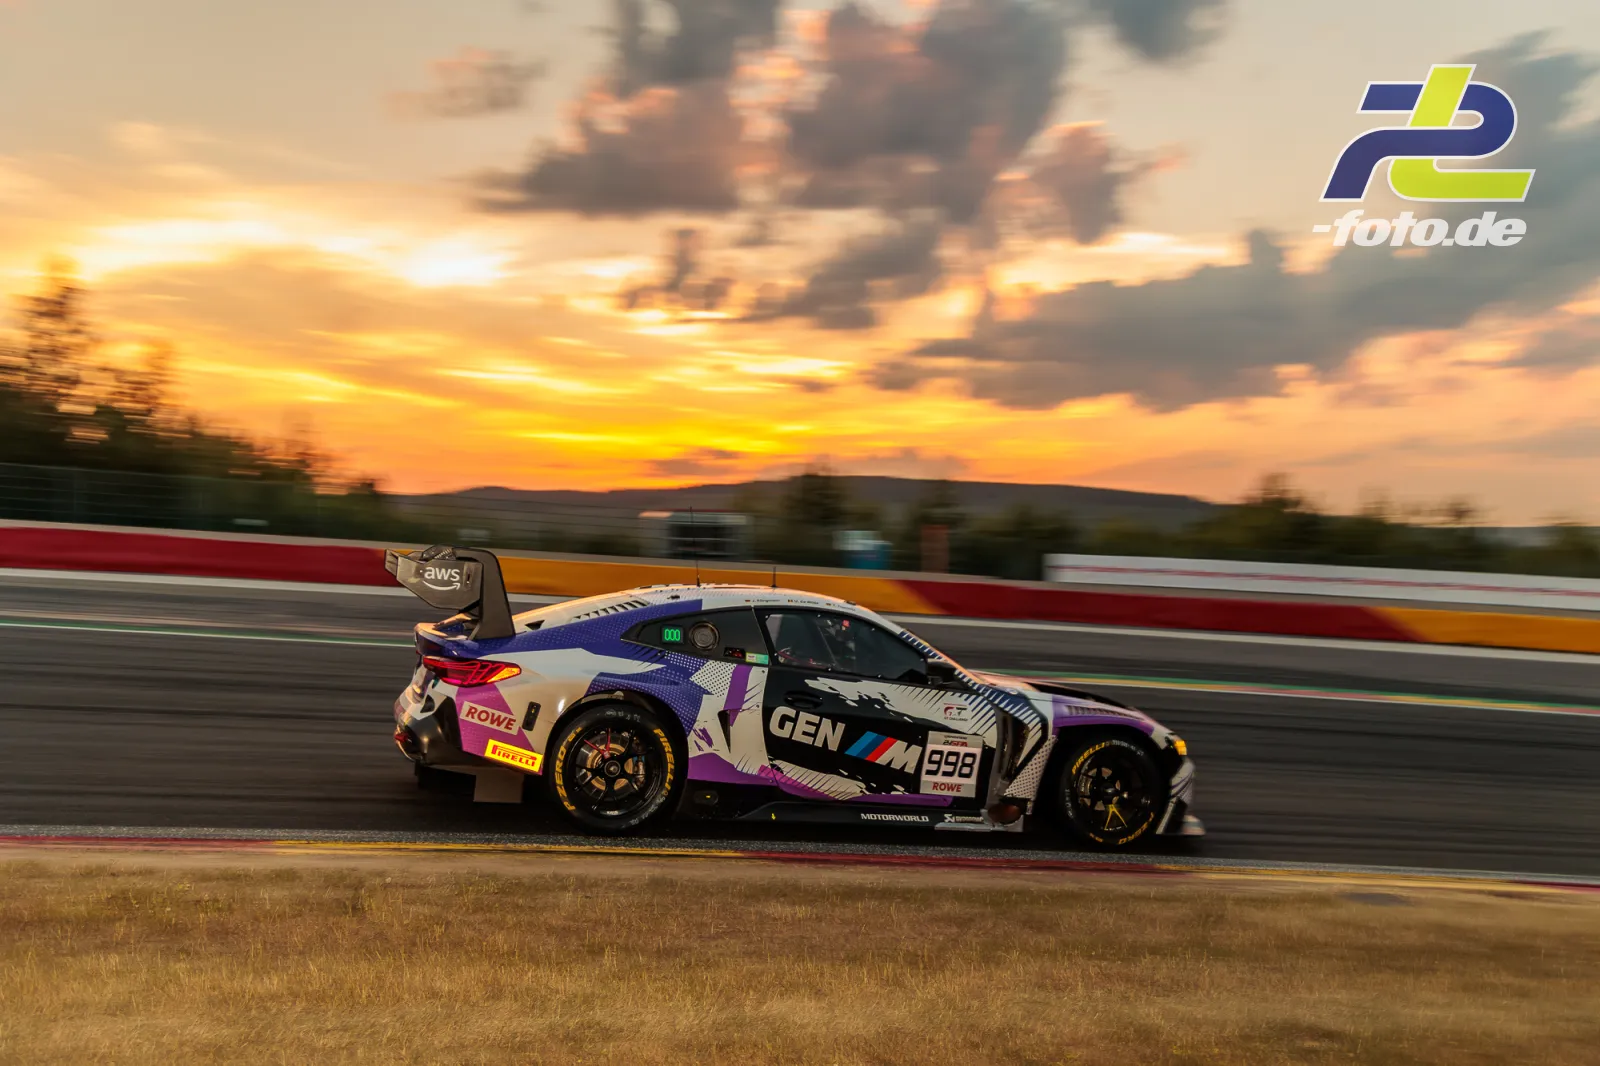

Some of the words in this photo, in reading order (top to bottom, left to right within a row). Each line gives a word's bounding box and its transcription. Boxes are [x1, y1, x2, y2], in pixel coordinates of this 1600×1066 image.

[424, 566, 460, 582] aws
[465, 705, 516, 731] ROWE
[769, 706, 846, 752] GEN
[491, 745, 537, 767] PIRELLI
[653, 728, 675, 791] PIRELLI
[925, 749, 977, 779] 998
[1071, 742, 1106, 775] PIRELLI
[932, 781, 962, 793] ROWE
[860, 813, 930, 823] MOTORWORLD
